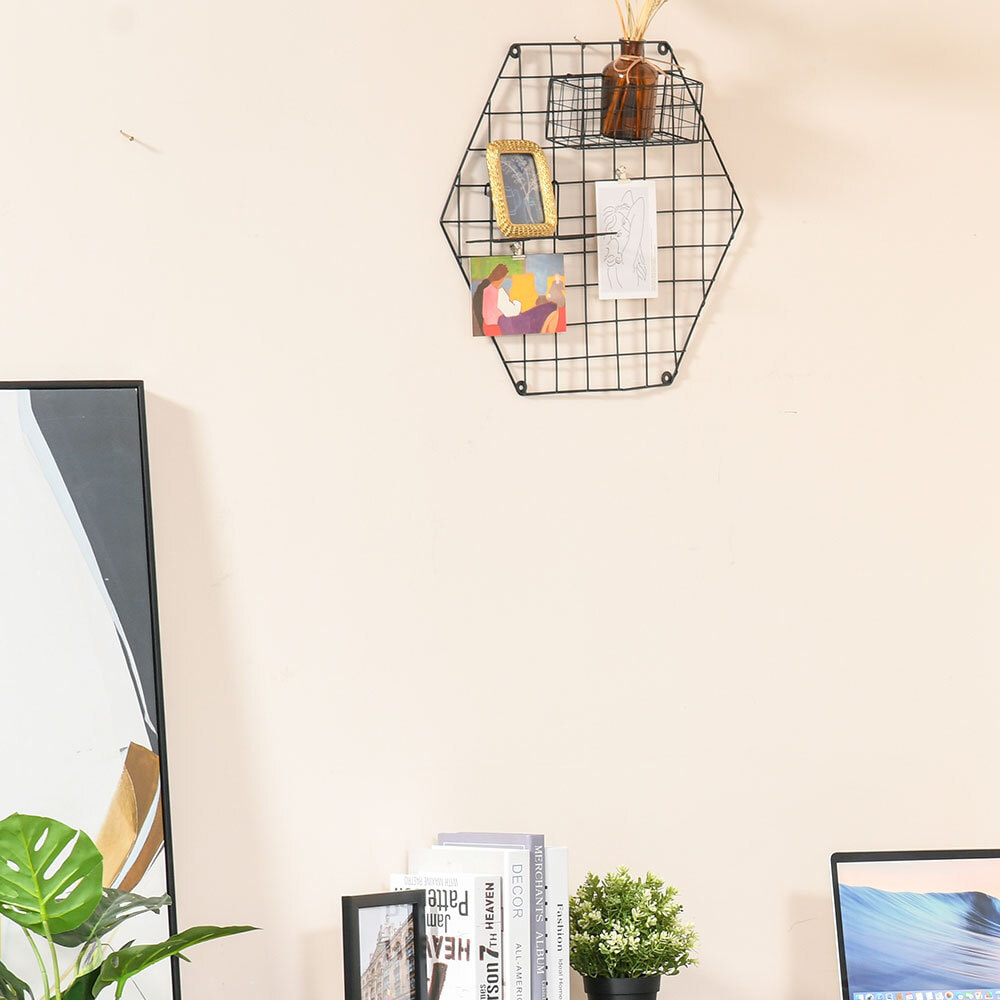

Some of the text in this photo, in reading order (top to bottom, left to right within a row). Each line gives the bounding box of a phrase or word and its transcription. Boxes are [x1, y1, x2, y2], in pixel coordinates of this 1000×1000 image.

[428, 889, 469, 916] Patte
[512, 864, 523, 918] DECOR
[534, 845, 544, 922] MERCHANTS
[426, 913, 451, 933] Jam
[485, 882, 494, 930] HEAVEN
[425, 935, 471, 961] HEA
[535, 931, 545, 974] ALBUM
